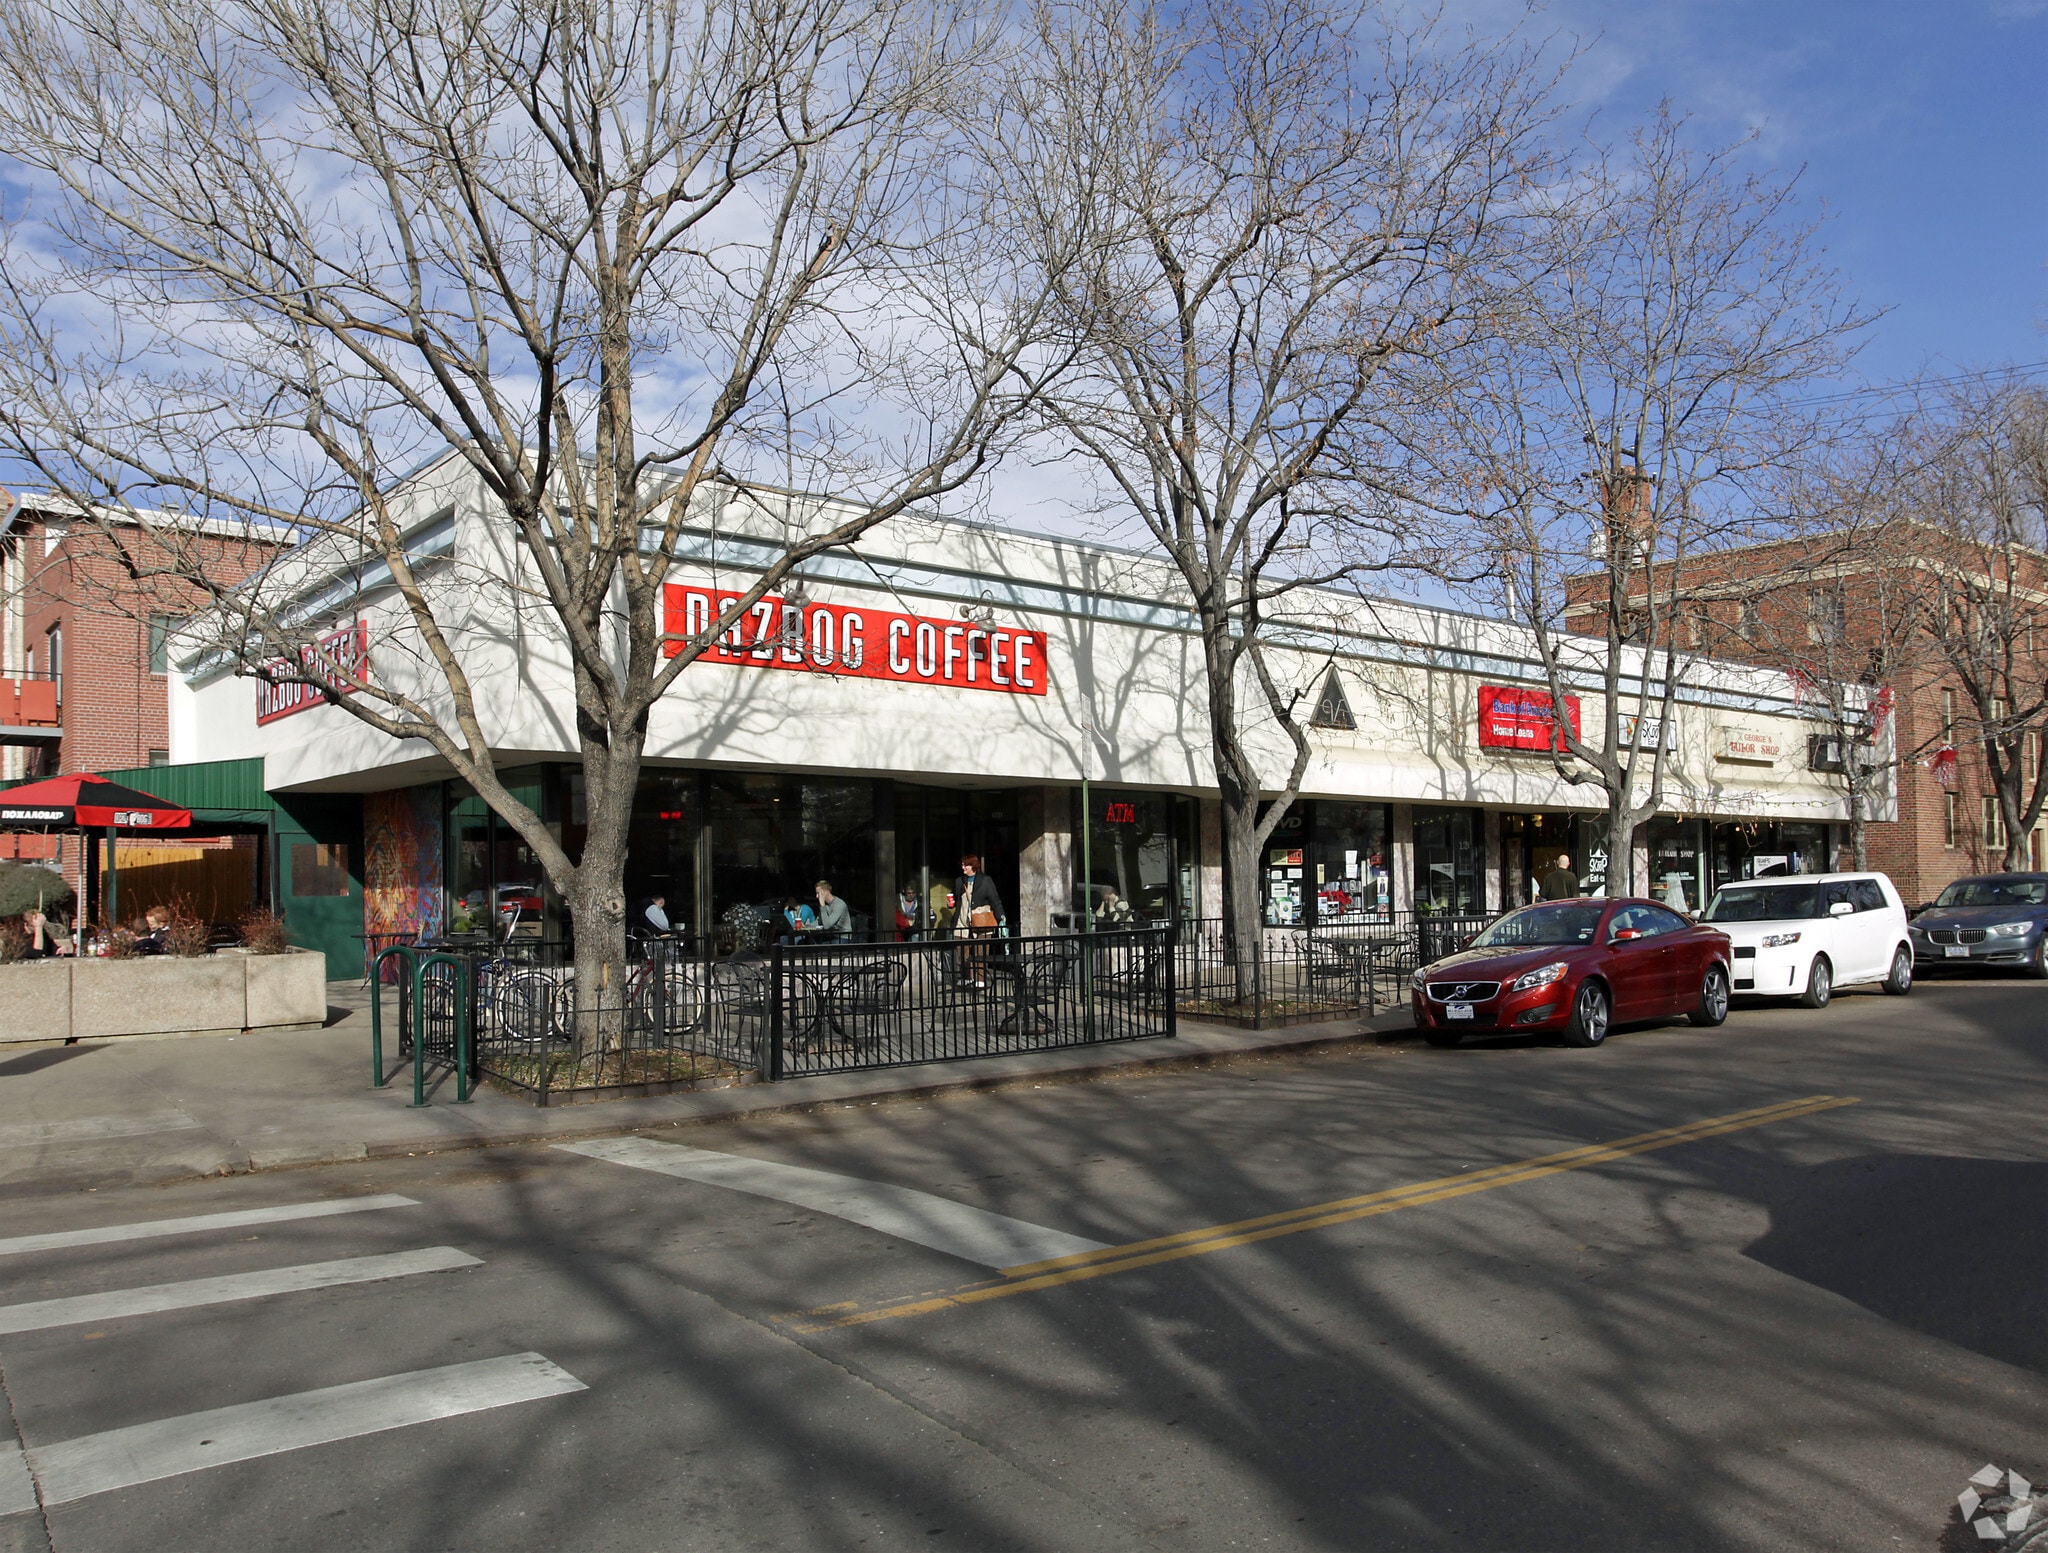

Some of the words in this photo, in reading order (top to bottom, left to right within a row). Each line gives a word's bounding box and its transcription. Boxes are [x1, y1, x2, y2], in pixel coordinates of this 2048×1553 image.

[686, 592, 863, 669] DAZBOG
[889, 618, 1034, 688] COFFEE
[1493, 699, 1516, 714] Bank
[1517, 701, 1525, 715] of
[1493, 724, 1514, 736] Home
[1514, 726, 1534, 738] Loans
[1744, 733, 1772, 743] GEORGE'S
[1729, 741, 1755, 753] TAILOR
[1760, 745, 1780, 755] SHOP
[1106, 802, 1135, 822] ATM
[1280, 816, 1302, 829] VD
